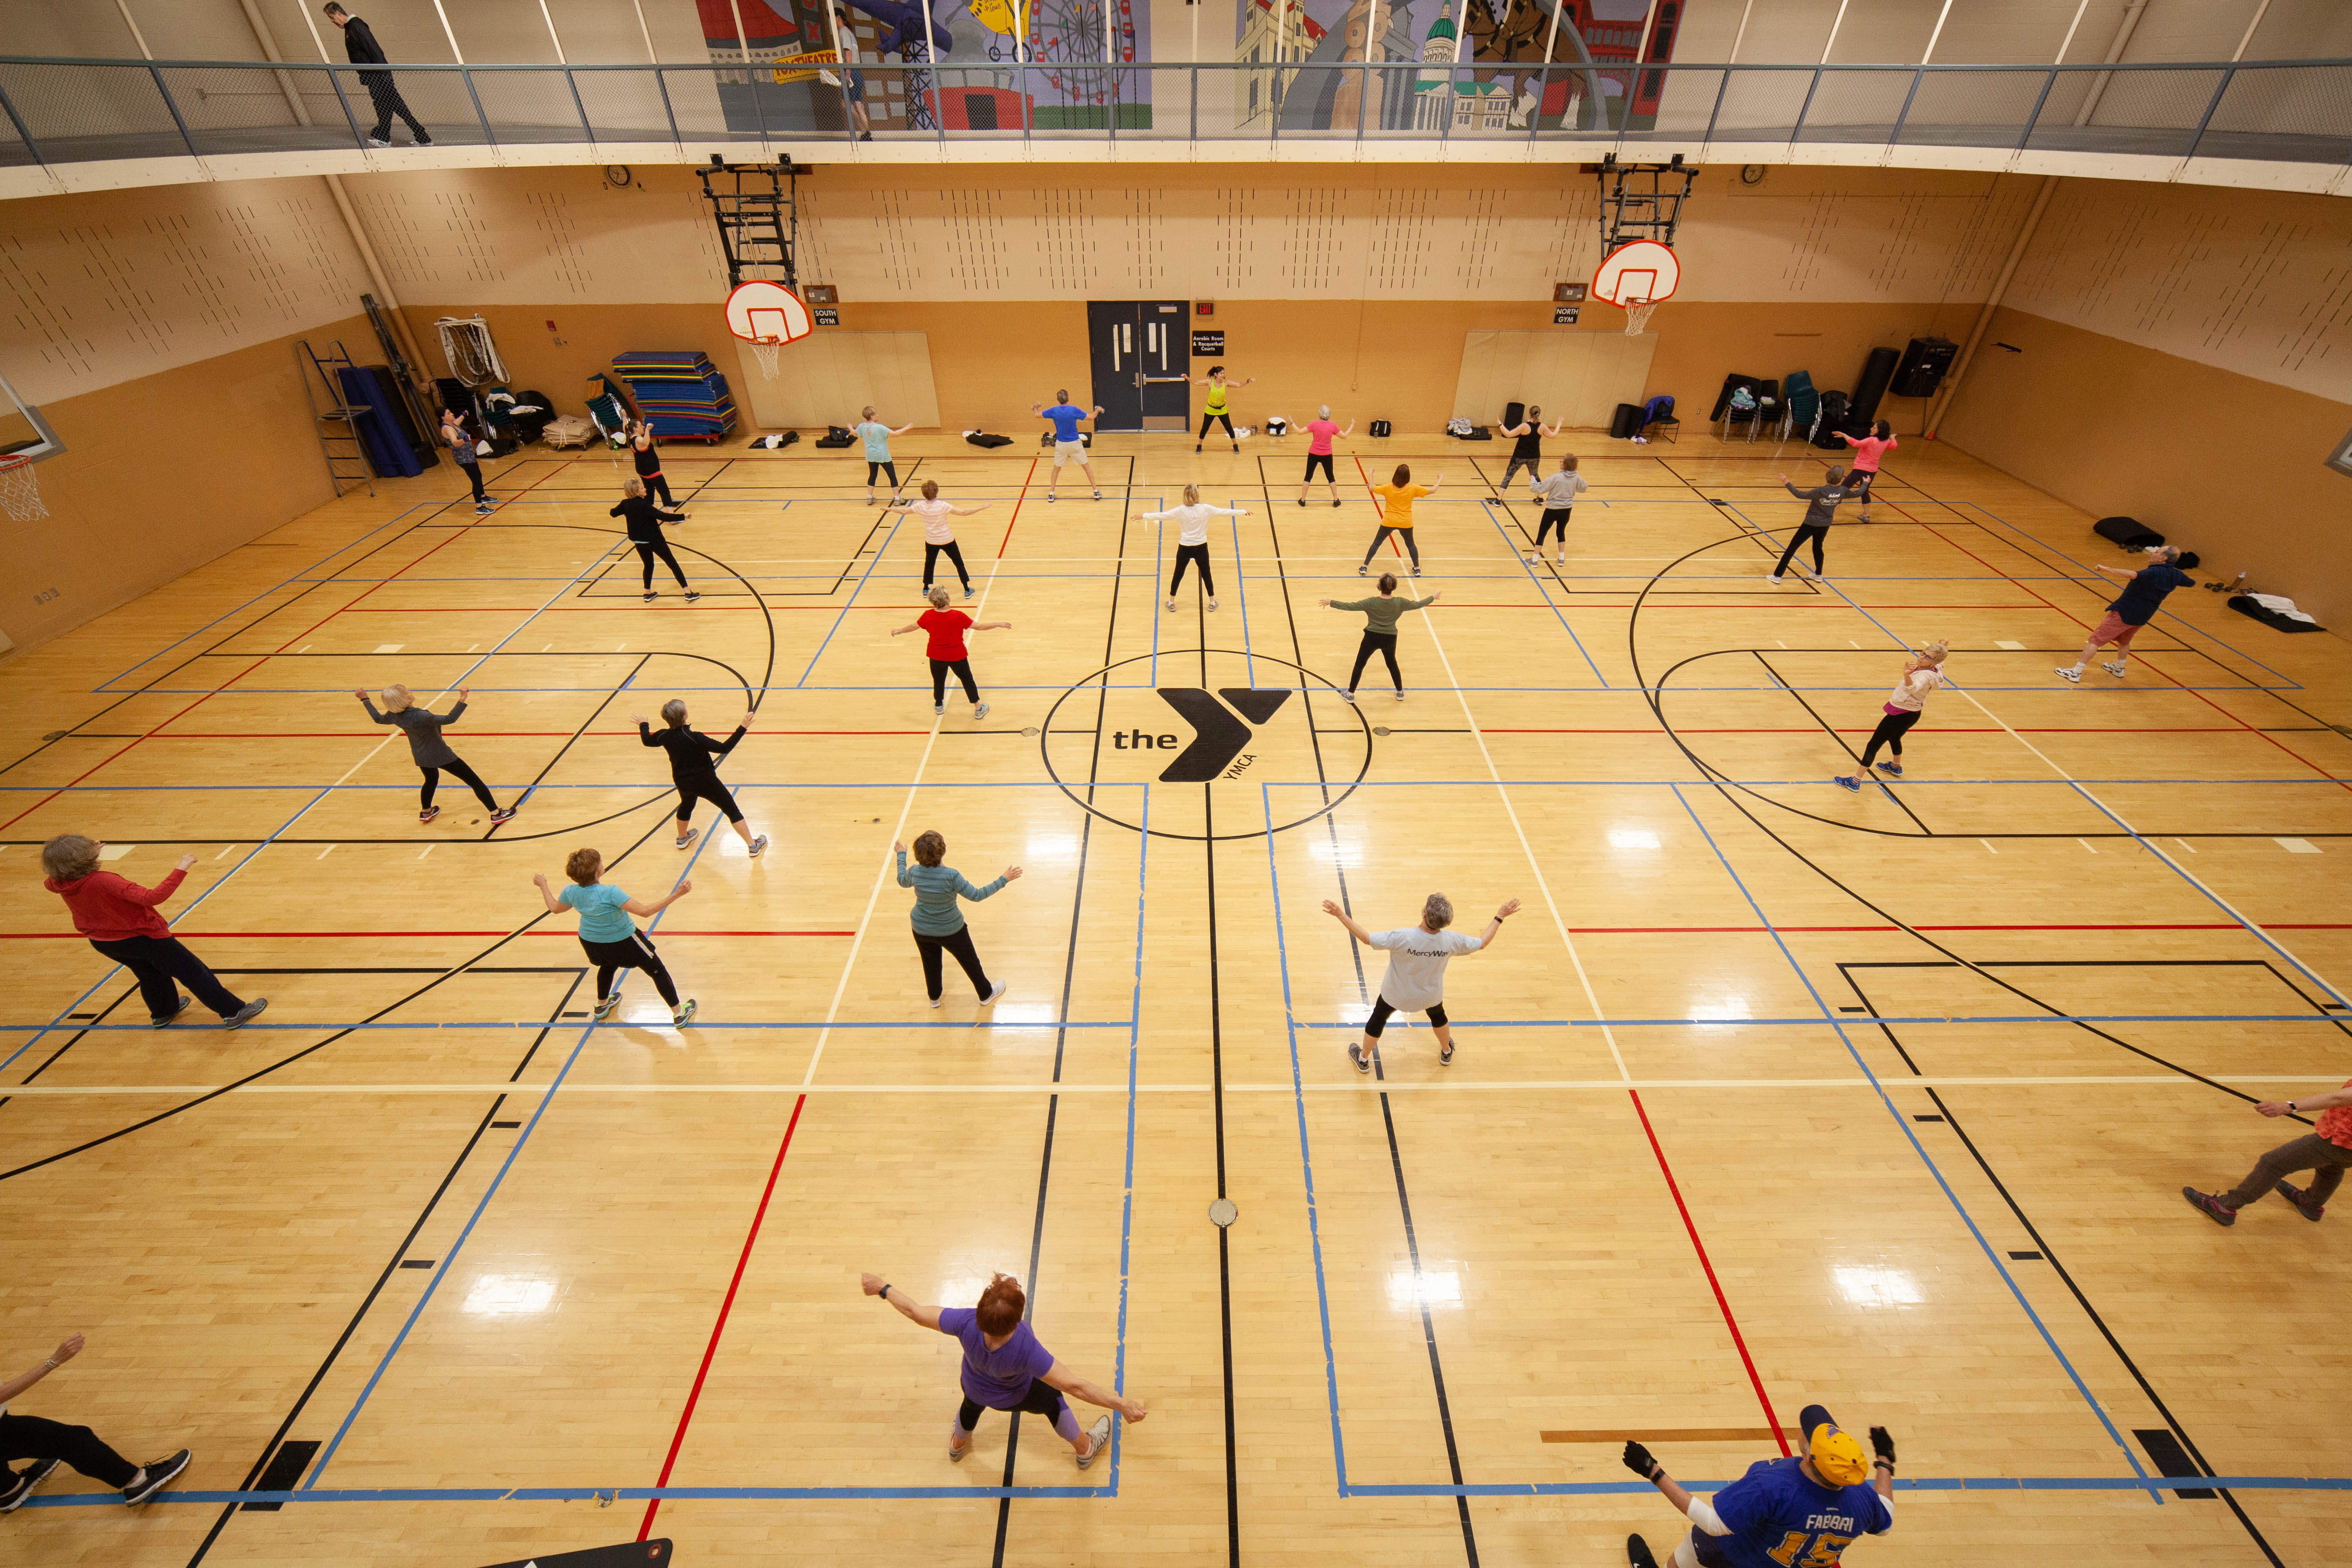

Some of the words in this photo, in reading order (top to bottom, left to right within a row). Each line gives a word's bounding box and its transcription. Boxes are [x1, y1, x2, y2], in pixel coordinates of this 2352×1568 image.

[1199, 304, 1211, 314] EXIT
[1113, 729, 1178, 749] the
[1223, 754, 1257, 780] YMCA
[1806, 1514, 1854, 1532] FABBRI
